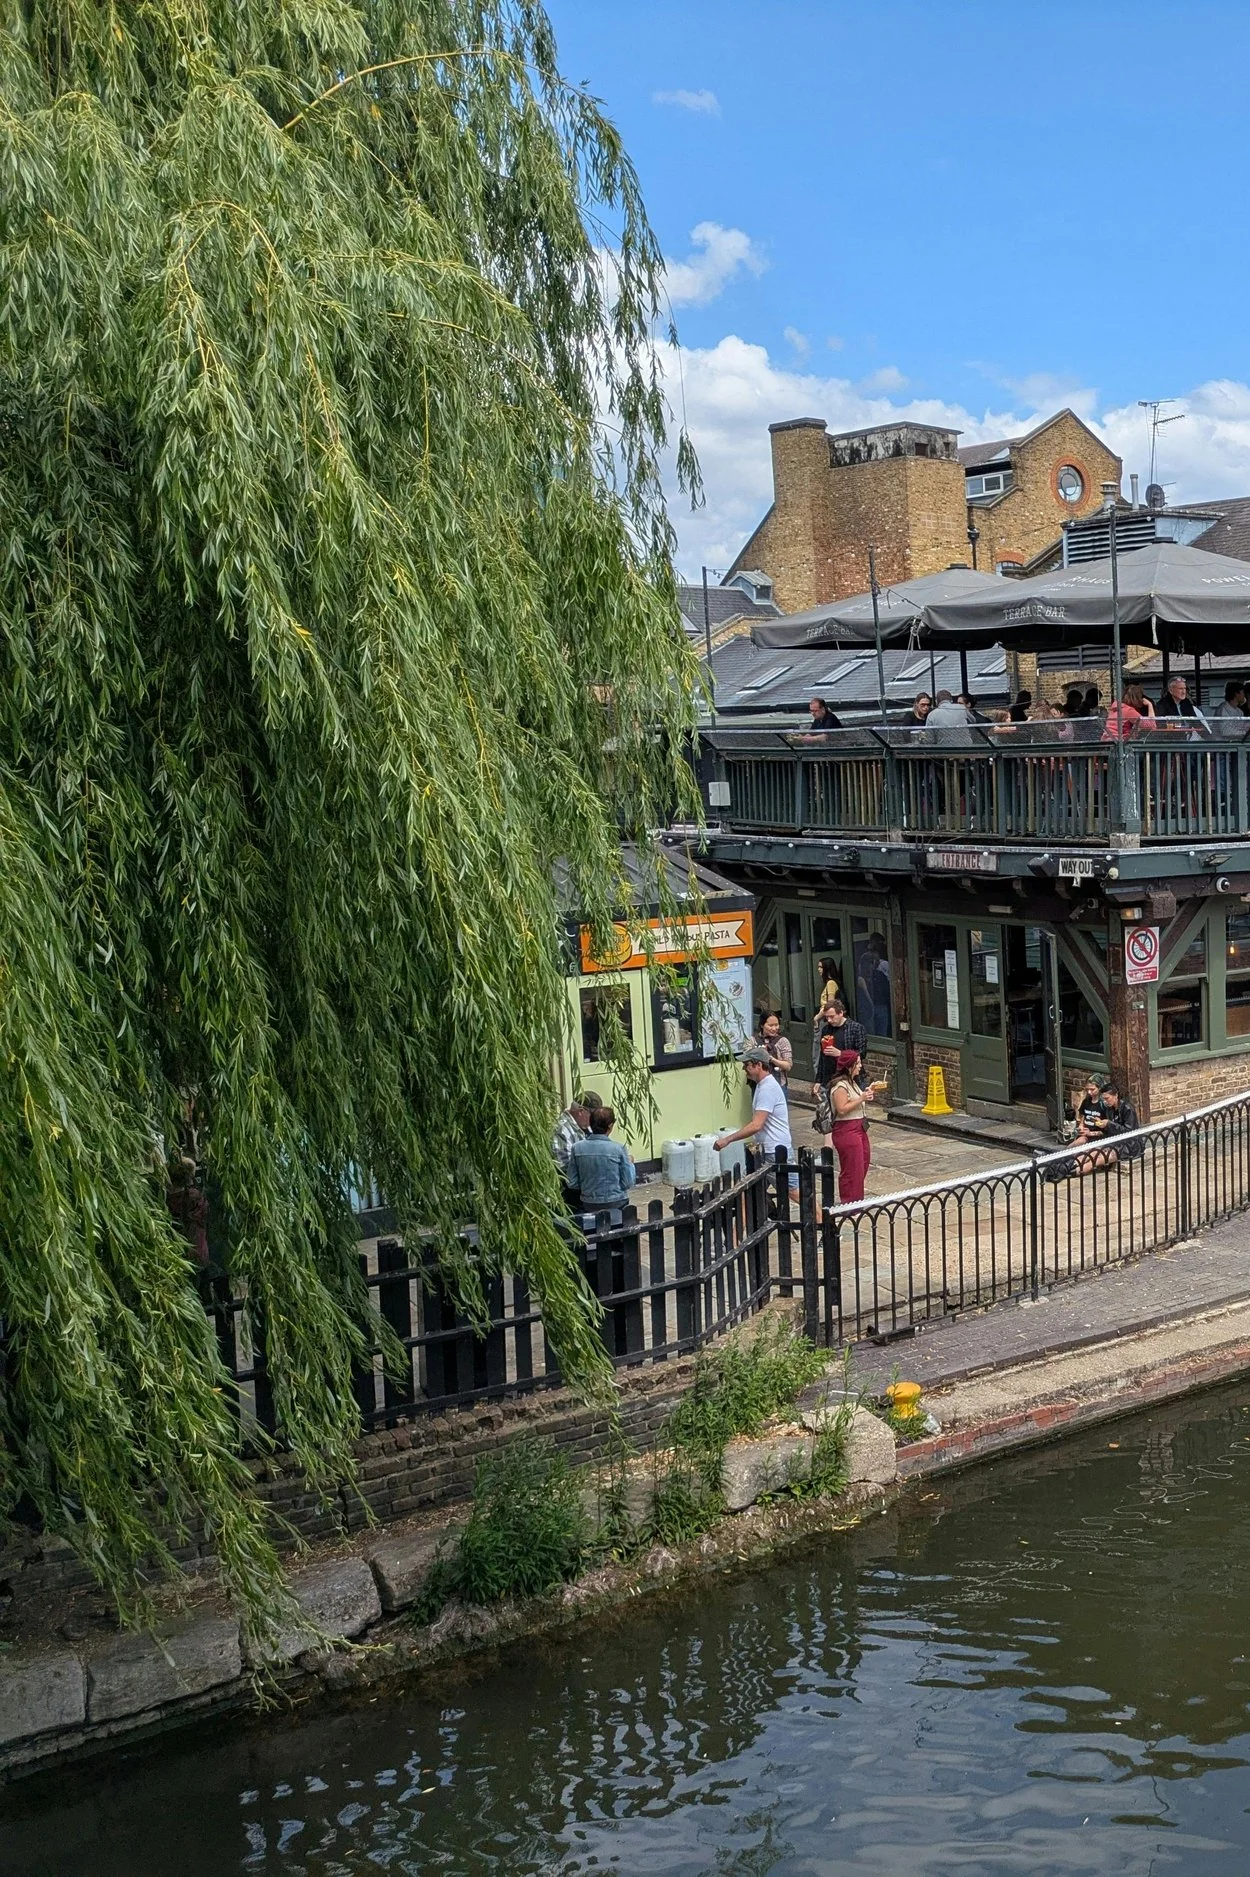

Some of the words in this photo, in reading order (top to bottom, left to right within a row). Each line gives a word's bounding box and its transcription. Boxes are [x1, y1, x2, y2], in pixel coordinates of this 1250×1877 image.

[1003, 605, 1043, 620] TERRACE
[1045, 606, 1065, 618] BAR
[806, 624, 838, 639] TERRACE
[941, 853, 981, 868] ENTRANCE
[1061, 860, 1077, 874] WAY
[705, 930, 730, 941] PASTA
